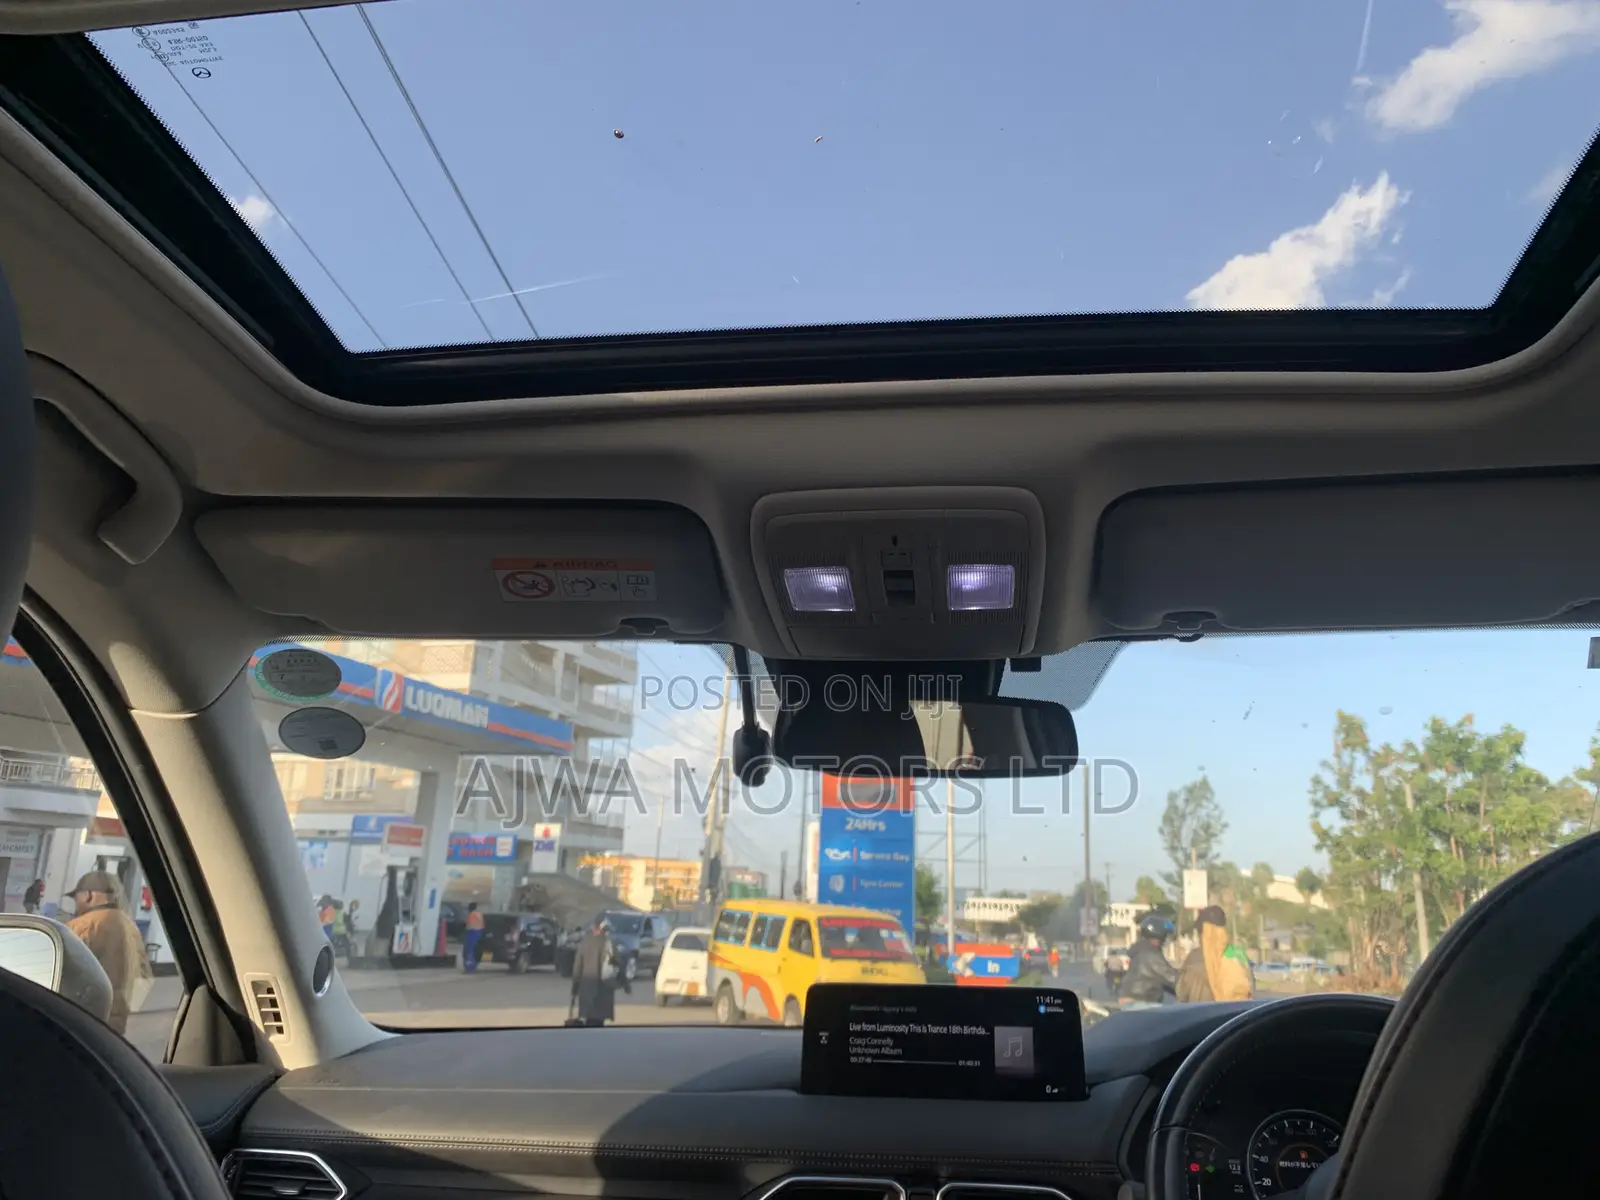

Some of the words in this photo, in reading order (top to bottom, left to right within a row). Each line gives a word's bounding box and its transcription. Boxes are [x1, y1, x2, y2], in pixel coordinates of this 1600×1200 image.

[845, 817, 887, 832] 24Hrs
[987, 960, 1001, 973] In
[1035, 996, 1054, 1004] 11:41
[849, 1022, 861, 1032] Live
[862, 1022, 876, 1032] from
[877, 1022, 909, 1035] Luminosity
[909, 1024, 921, 1034] This
[928, 1024, 948, 1034] Trance
[948, 1025, 963, 1034] 18th
[849, 1036, 866, 1046] Craig
[867, 1037, 894, 1046] Connelly
[849, 1046, 880, 1055] Unknown
[881, 1046, 903, 1055] Album
[1259, 1155, 1269, 1163] 40
[1261, 1177, 1272, 1186] 20
